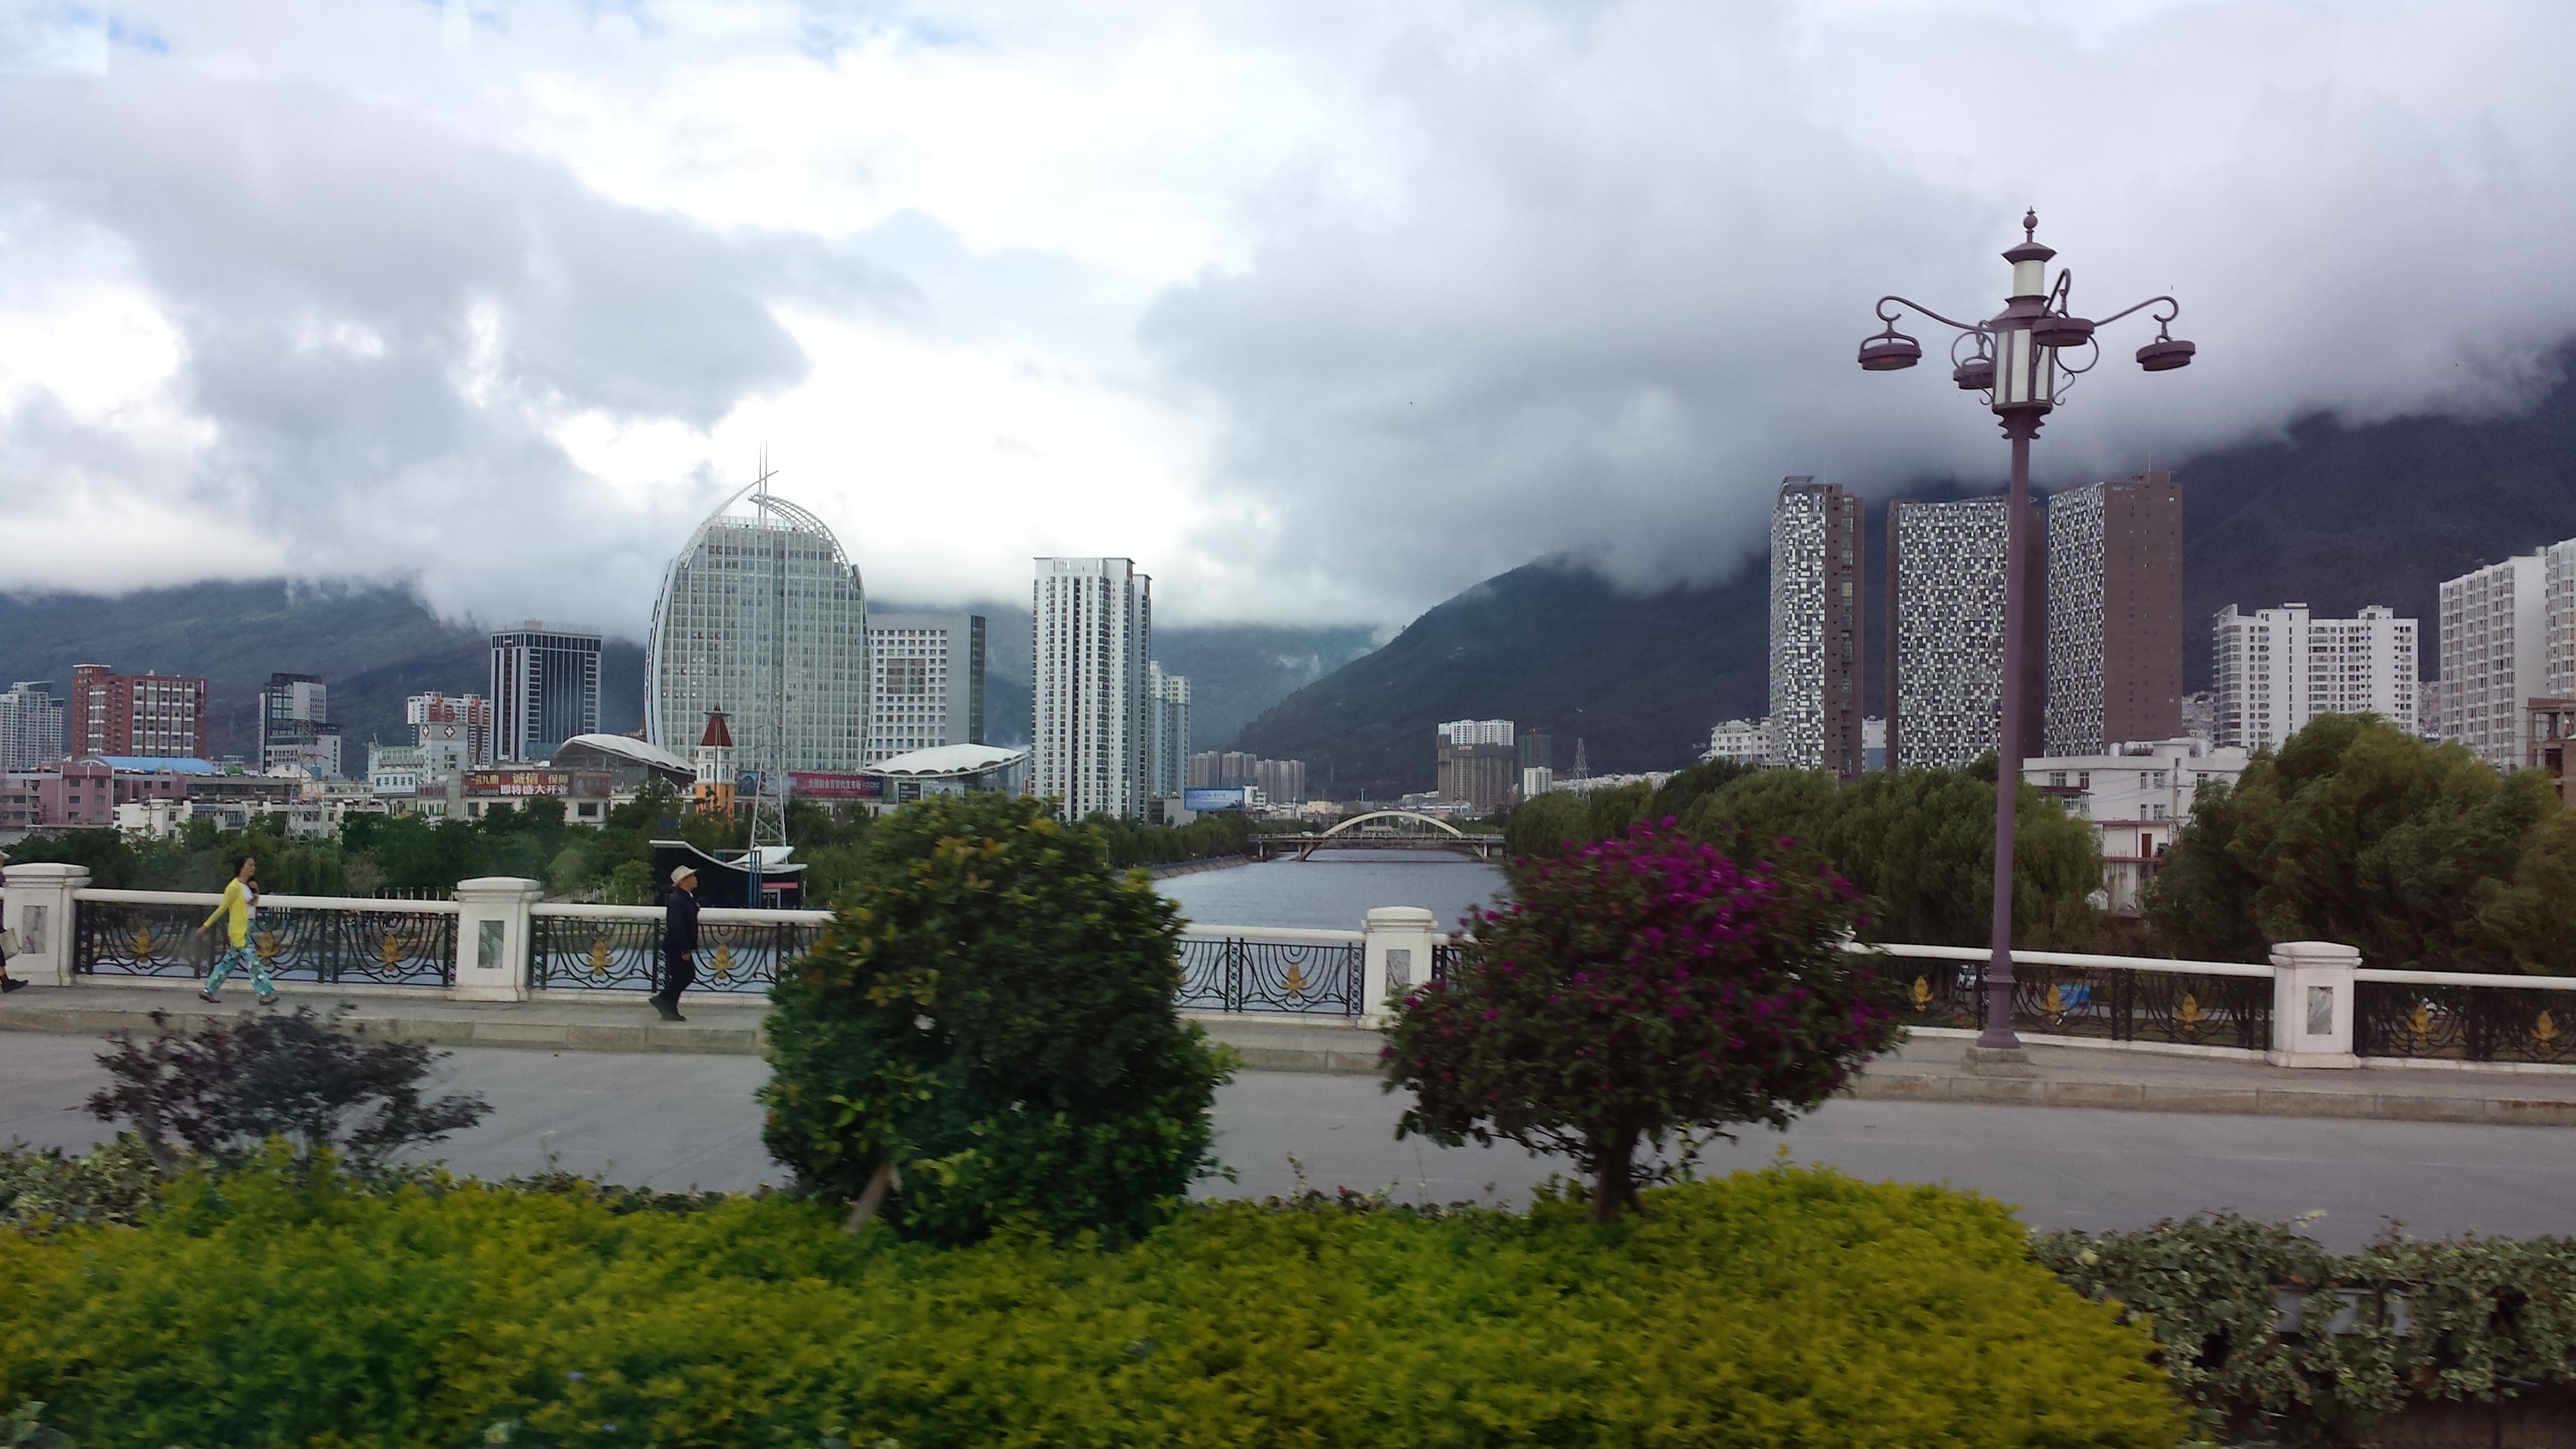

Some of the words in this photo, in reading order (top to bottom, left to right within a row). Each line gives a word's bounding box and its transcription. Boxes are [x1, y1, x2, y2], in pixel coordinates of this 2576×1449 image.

[512, 772, 539, 785] 诚信
[547, 774, 569, 785] 保障
[500, 784, 568, 796] 即将盛大开业
